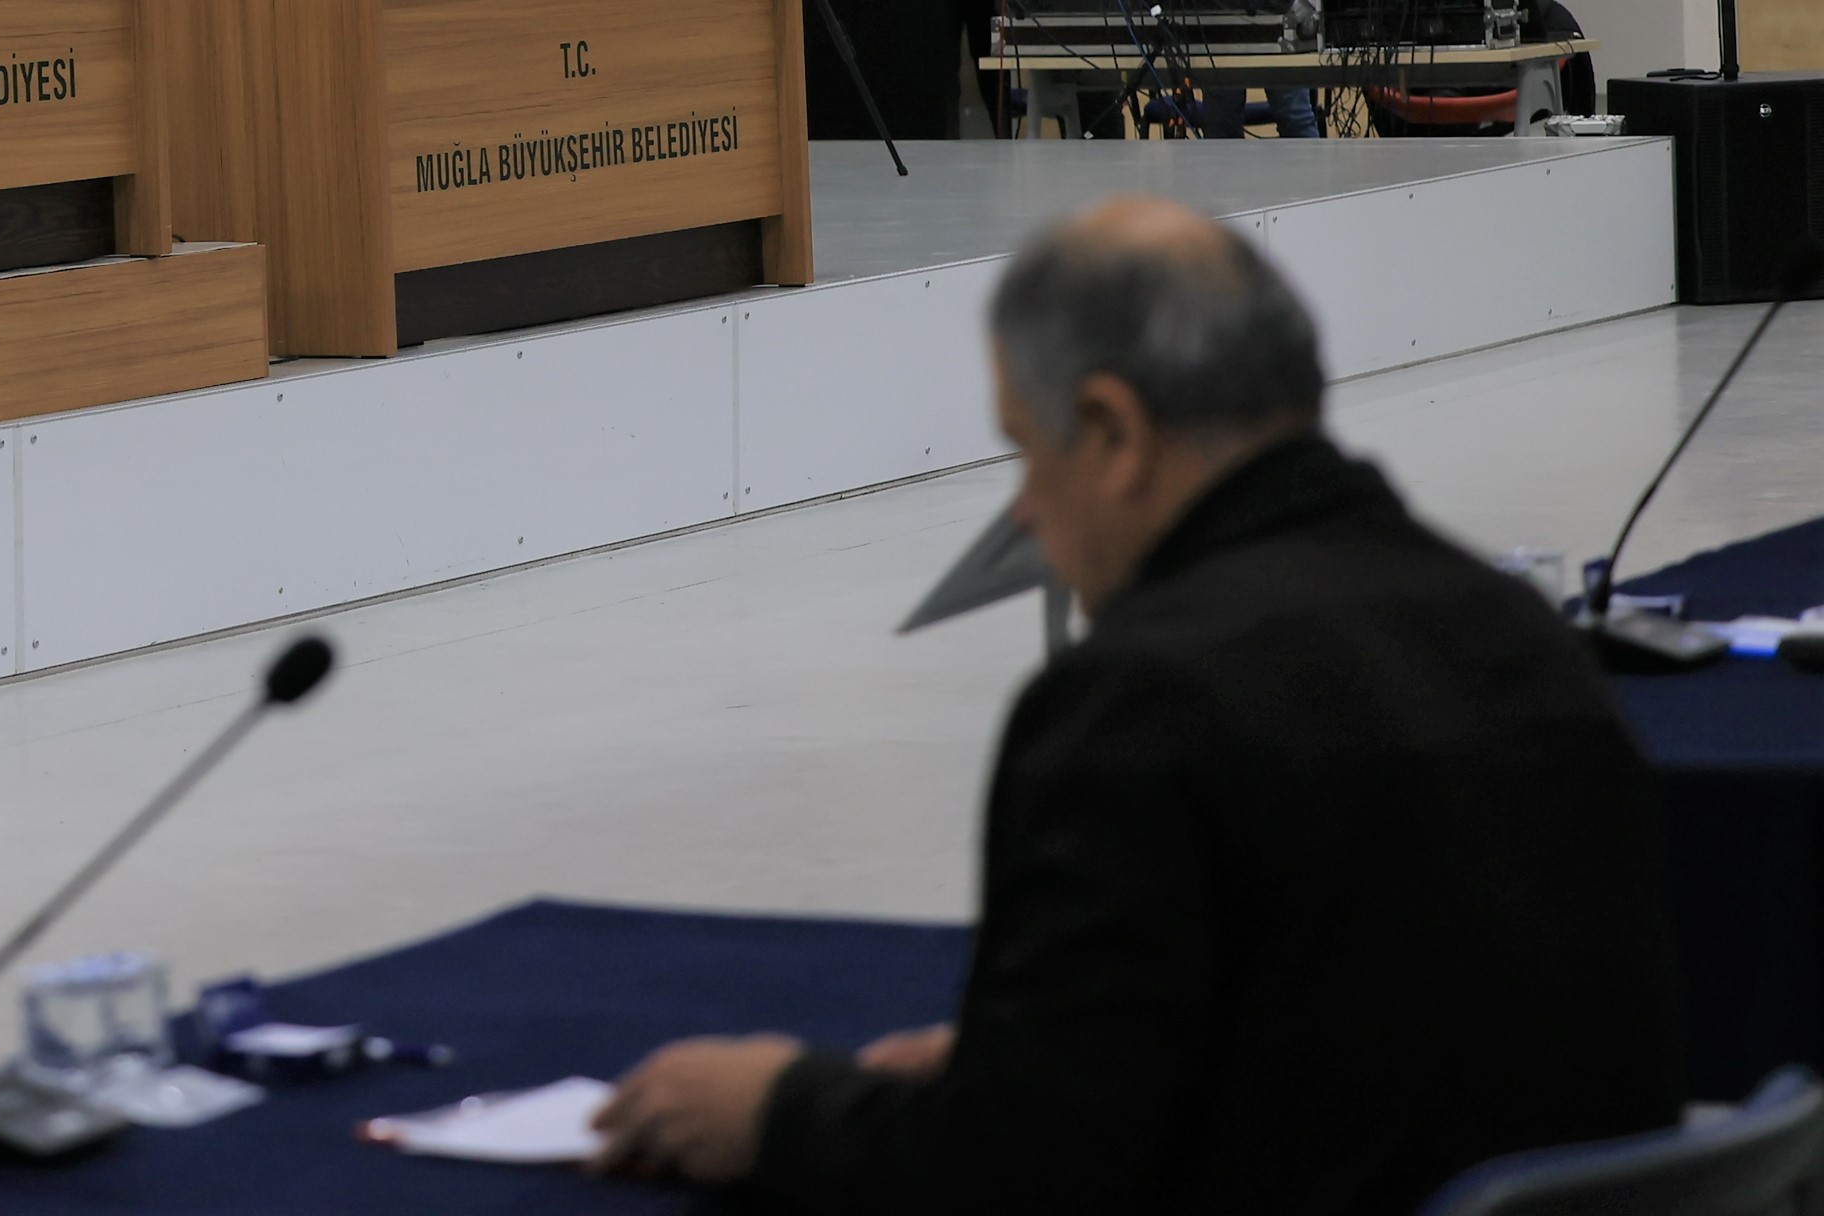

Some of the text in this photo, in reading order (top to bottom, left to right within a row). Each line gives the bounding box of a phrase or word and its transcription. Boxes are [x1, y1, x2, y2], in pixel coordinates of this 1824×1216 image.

[560, 40, 596, 78] T.C.
[416, 106, 738, 193] MUĞLA BÜYÜKŞEHİR BELEDİYESİ
